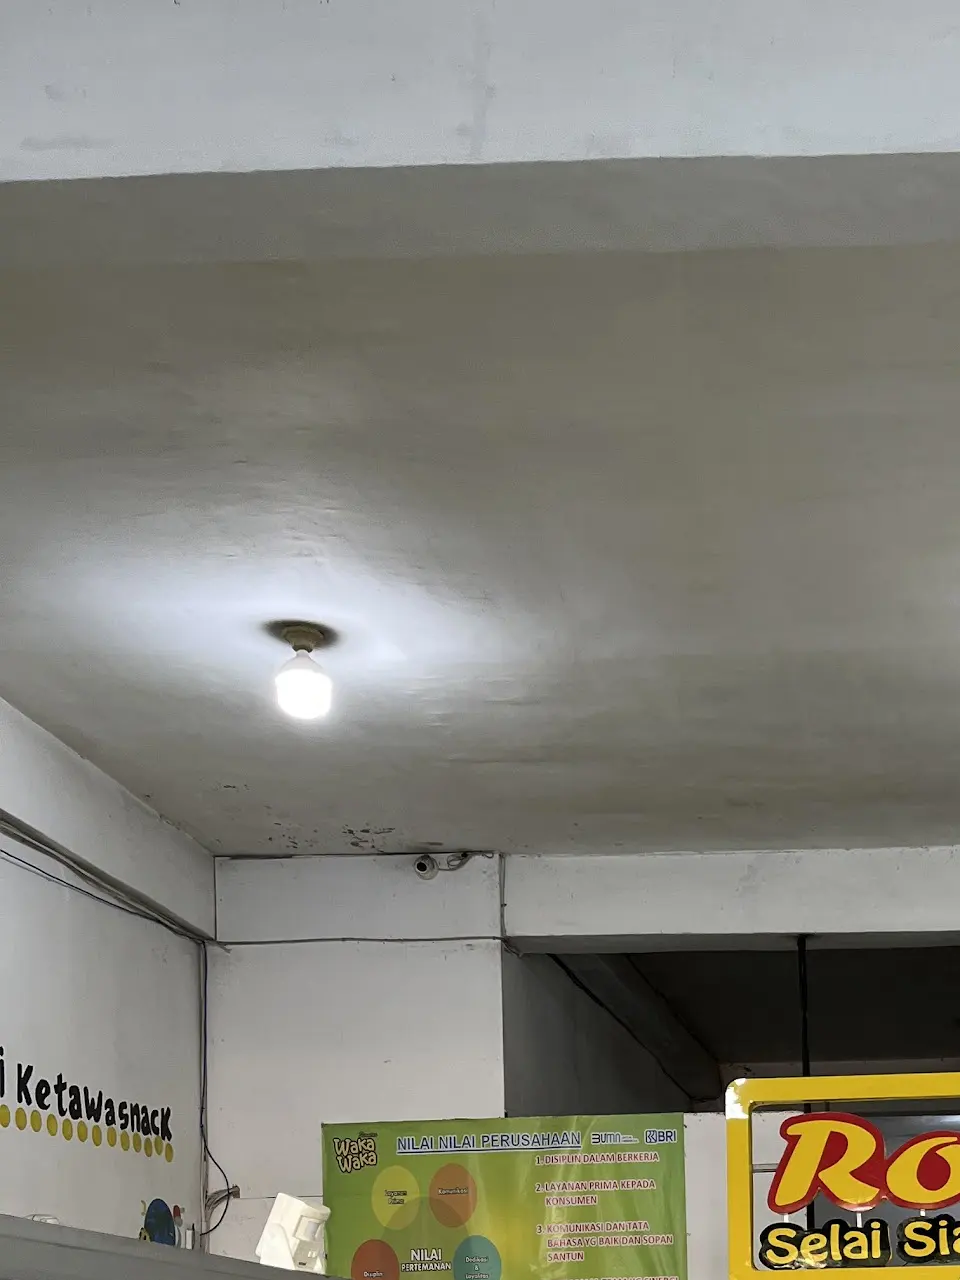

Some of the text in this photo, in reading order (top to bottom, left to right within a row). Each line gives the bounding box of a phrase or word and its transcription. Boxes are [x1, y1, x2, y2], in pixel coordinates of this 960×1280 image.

[16, 1063, 172, 1141] Ketawasnack
[397, 1131, 581, 1150] NILAI NILAI PERUSAHAAN
[659, 1130, 676, 1142] BRI
[333, 1137, 375, 1156] Waka
[336, 1152, 378, 1173] Waka
[545, 1155, 582, 1164] DISIPLIN
[583, 1153, 615, 1163] DALAM
[617, 1152, 660, 1162] BERKERJA
[545, 1182, 588, 1192] LAYANAN
[589, 1180, 618, 1190] PRIMA
[621, 1179, 655, 1189] KEPADA
[546, 1196, 597, 1206] KONSUMEN
[547, 1223, 604, 1234] KOMUNIKASI
[605, 1222, 625, 1231] DAN
[626, 1221, 649, 1230] TATA
[547, 1235, 673, 1248] BAHASA YG BAIK DAN SOPAN
[765, 1221, 882, 1266] Selai
[410, 1248, 442, 1261] NILAI
[547, 1252, 584, 1262] SANTUN
[401, 1262, 451, 1272] PERTEMANAN
